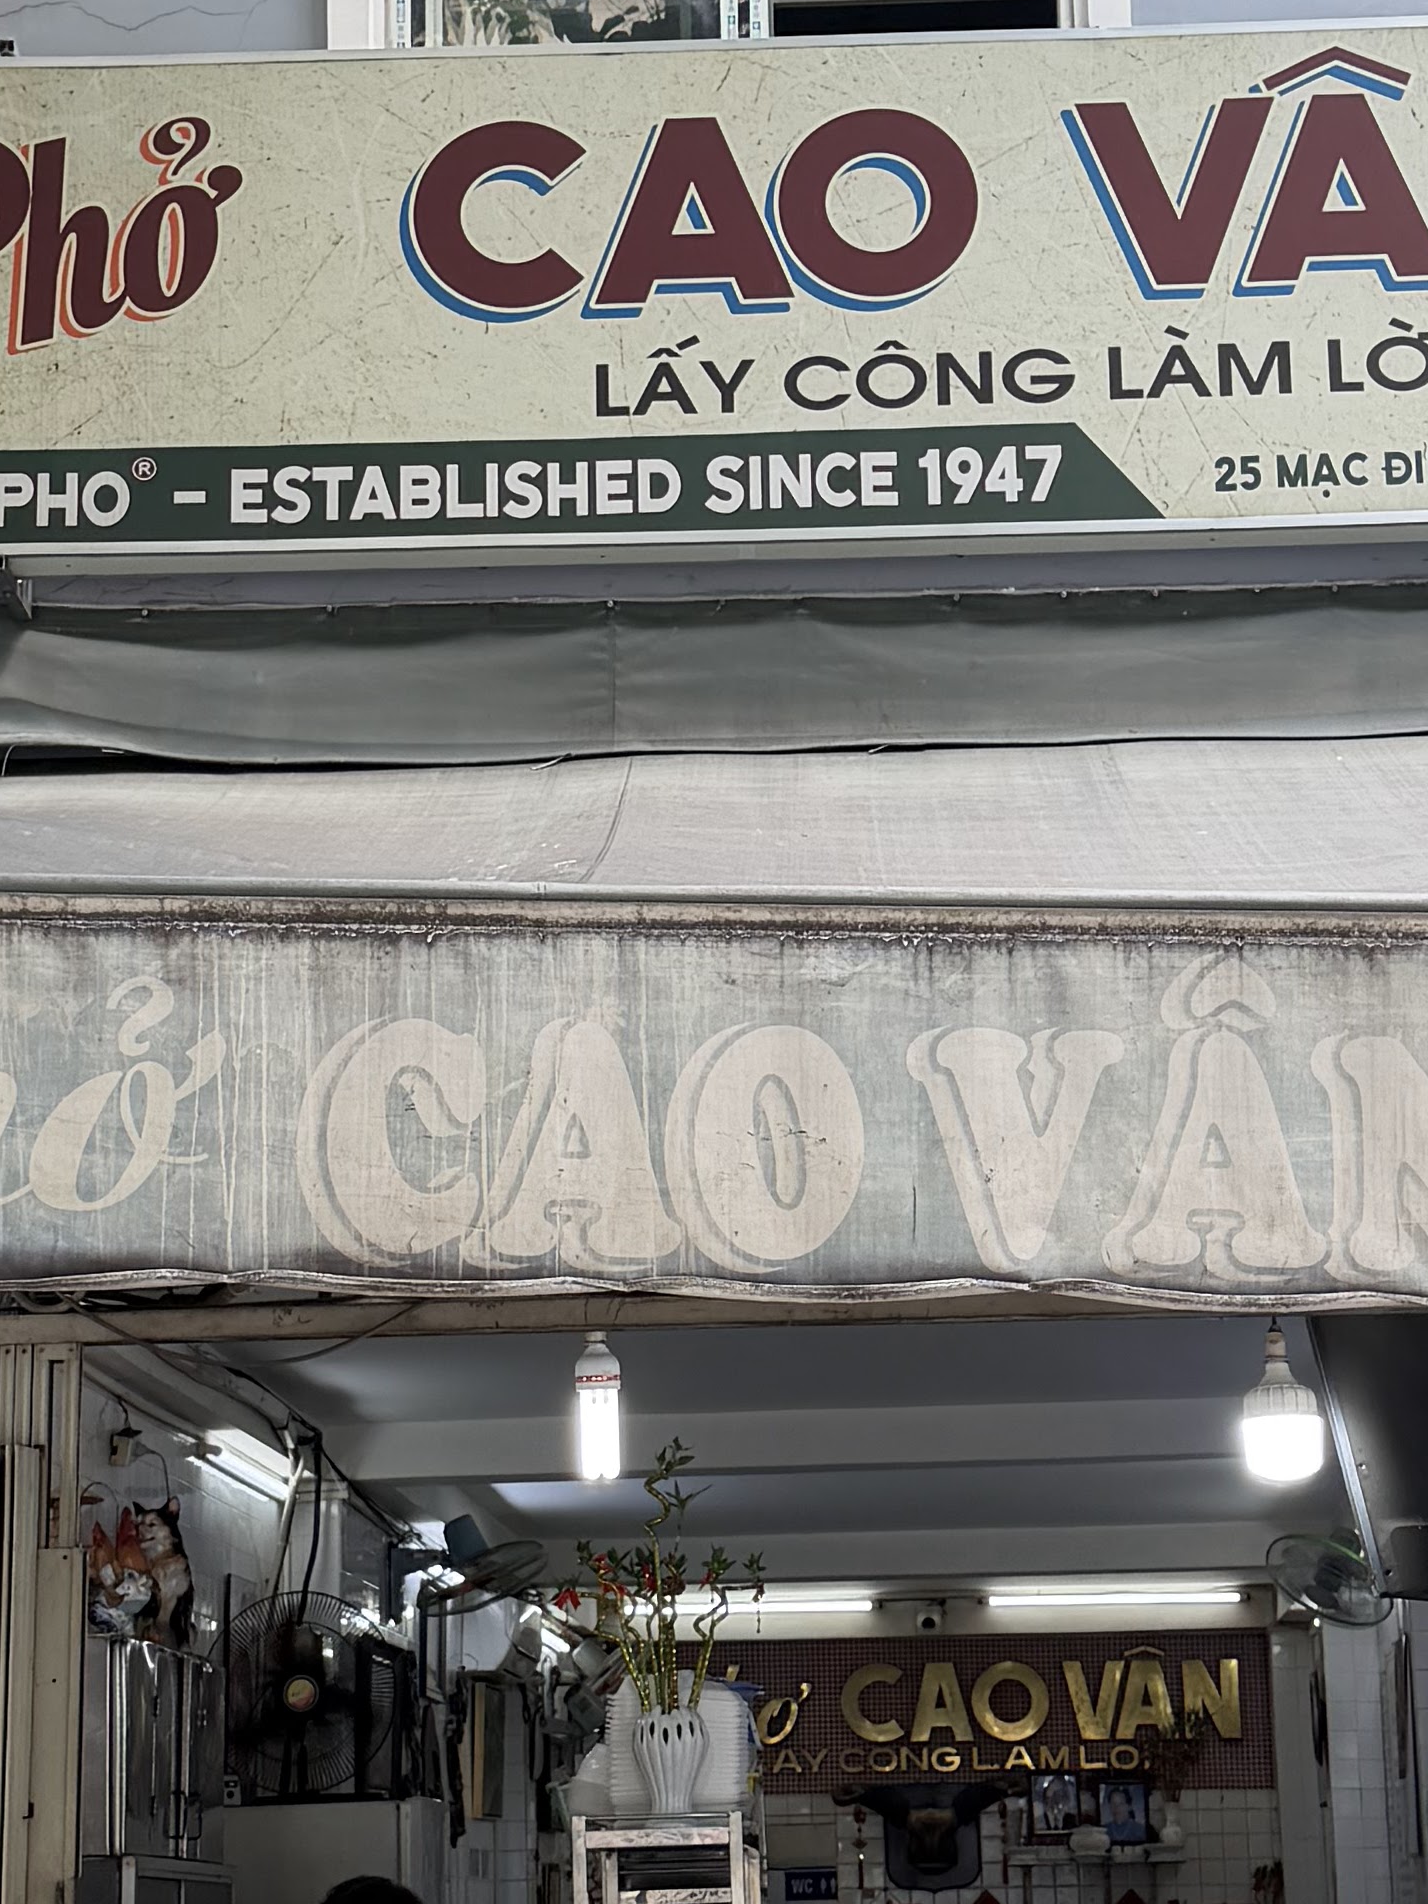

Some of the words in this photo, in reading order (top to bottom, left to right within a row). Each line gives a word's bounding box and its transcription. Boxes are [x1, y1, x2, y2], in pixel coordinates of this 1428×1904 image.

[399, 108, 980, 324] CAO
[594, 334, 755, 418] LẤY
[782, 339, 1077, 411] CÔNG
[1107, 326, 1294, 402] LÀM
[229, 453, 683, 525] ESTABLISHED
[703, 449, 900, 514] SINCE
[917, 443, 1065, 508] 1947
[1214, 455, 1262, 493] 25
[1275, 451, 1370, 499] MẠC
[296, 1014, 866, 1274] CAO
[840, 1659, 1051, 1744] CAO
[1061, 1645, 1243, 1741] VÂN
[790, 1878, 814, 1894] WC
